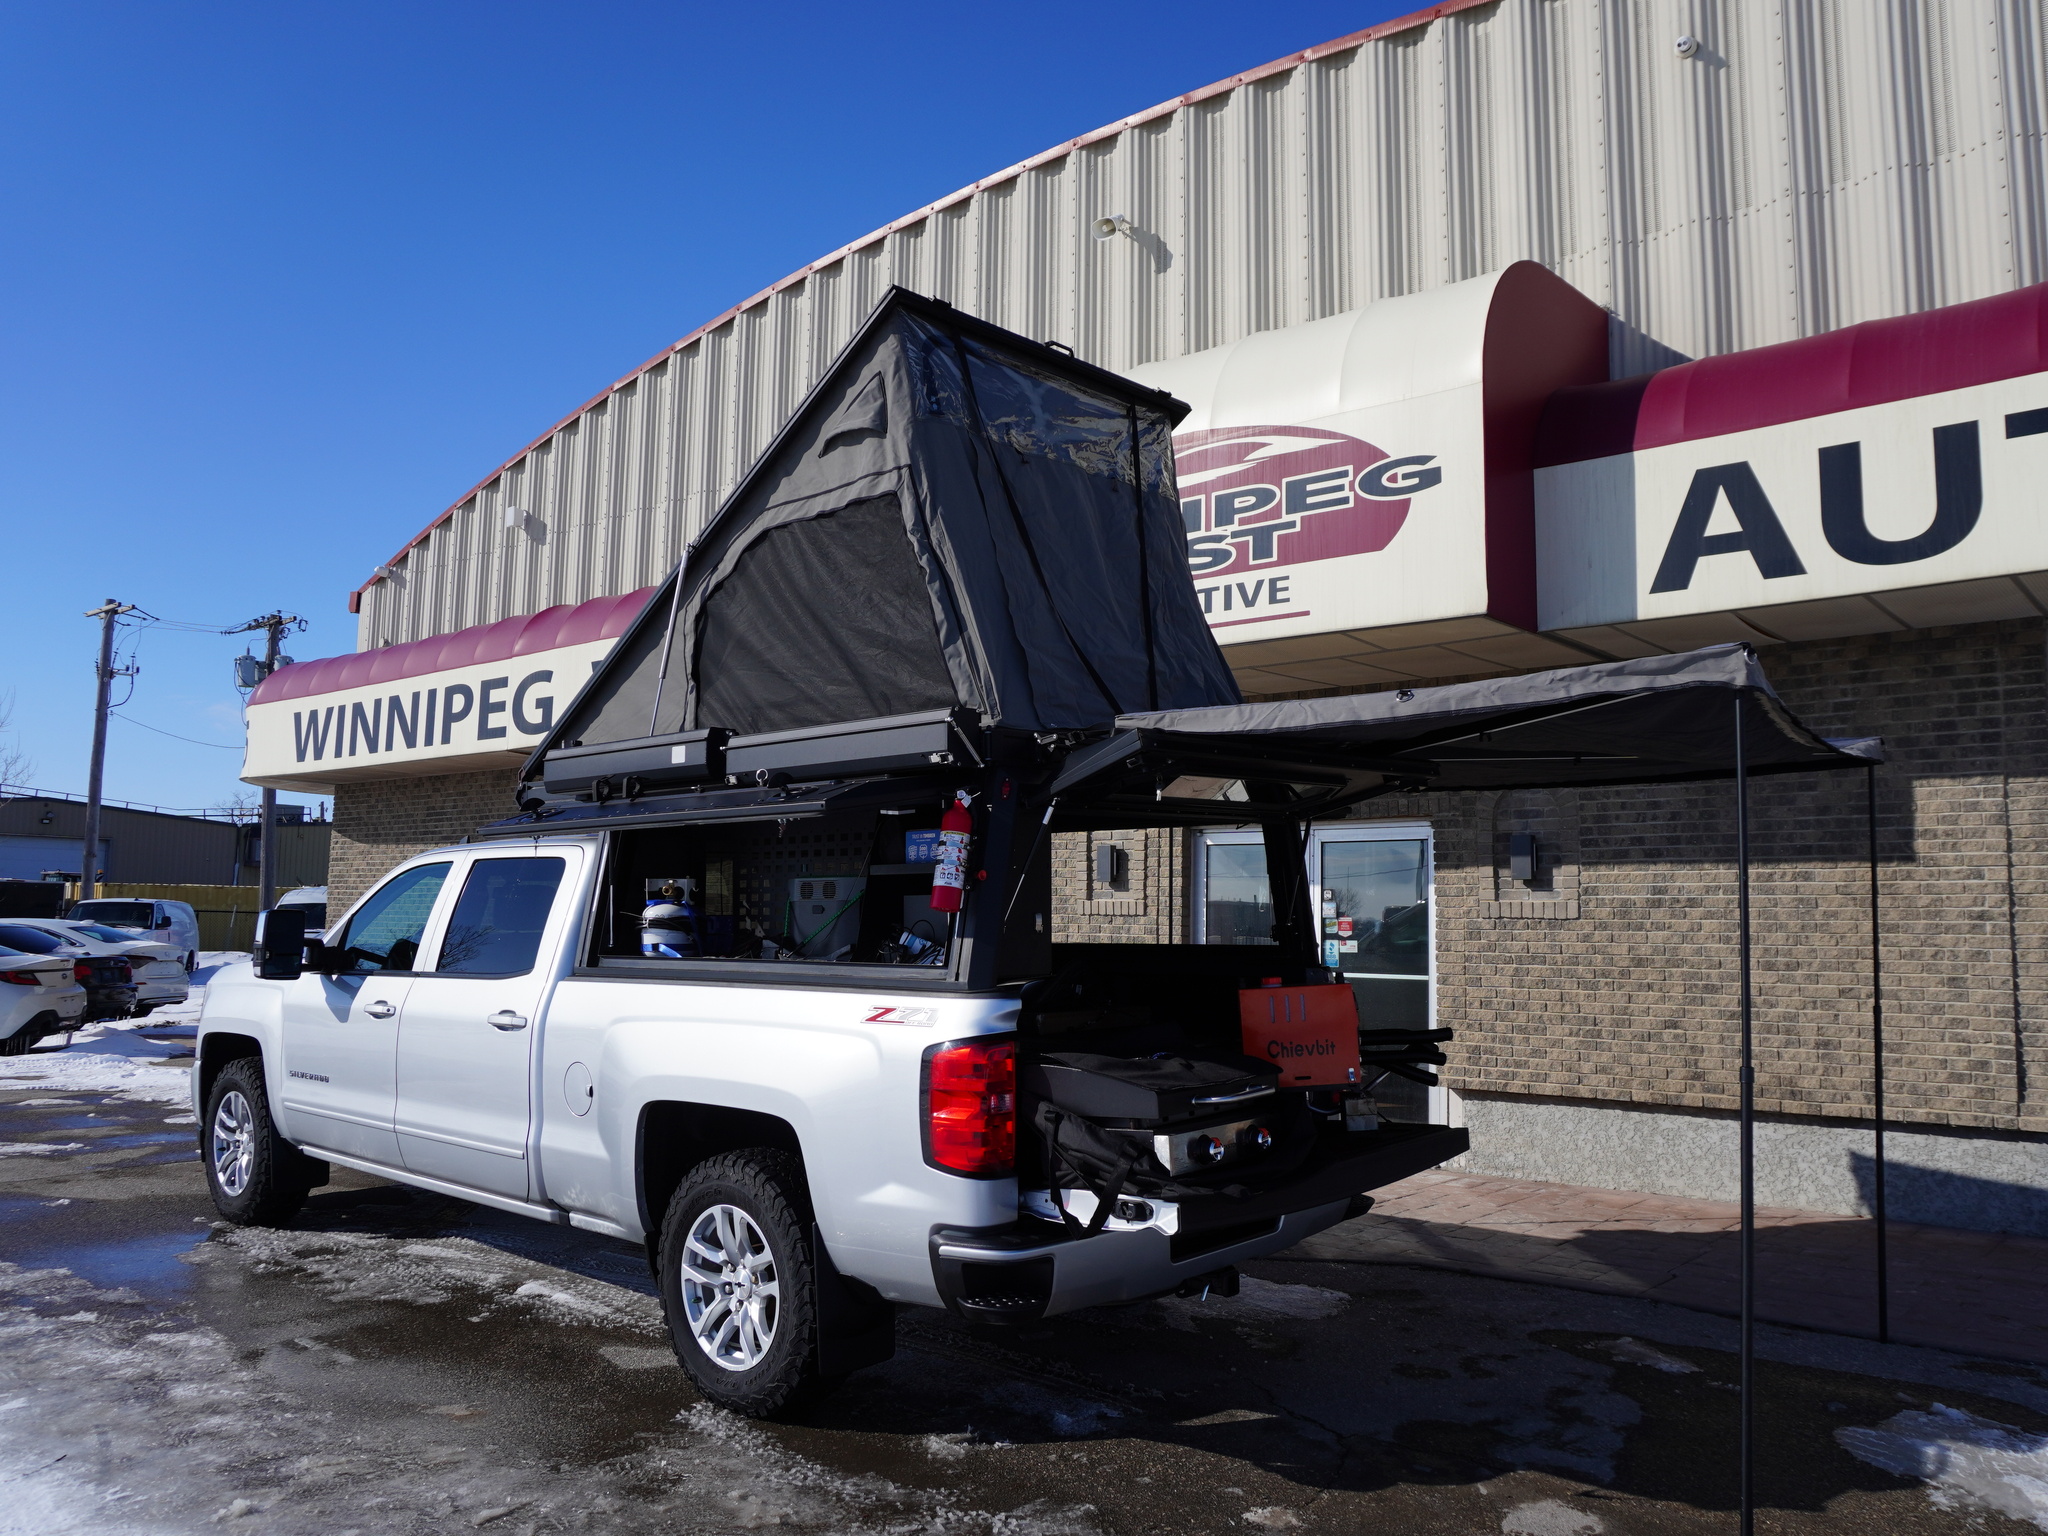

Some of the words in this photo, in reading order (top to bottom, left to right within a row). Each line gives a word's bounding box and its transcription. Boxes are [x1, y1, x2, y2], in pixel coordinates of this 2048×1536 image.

[293, 669, 555, 763] WINNIPEG
[864, 1006, 939, 1025] Z71
[1267, 1039, 1336, 1059] Chievbit
[289, 1070, 330, 1083] SILVERADO
